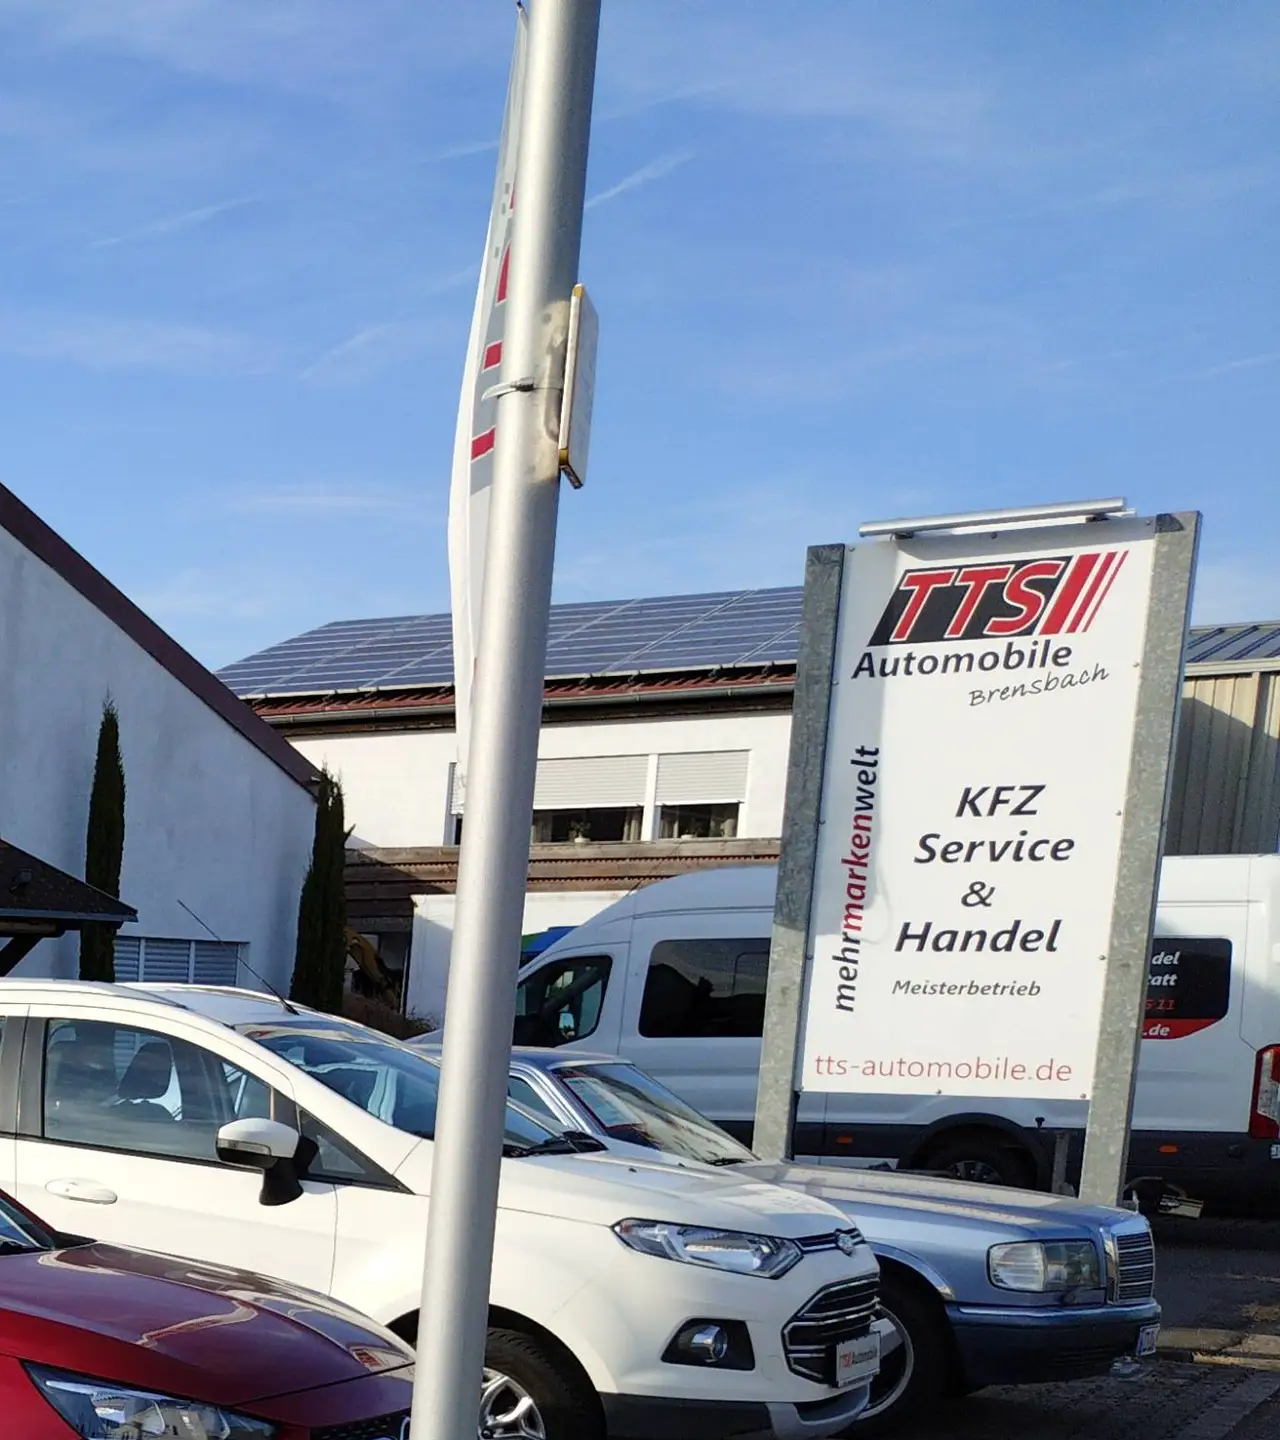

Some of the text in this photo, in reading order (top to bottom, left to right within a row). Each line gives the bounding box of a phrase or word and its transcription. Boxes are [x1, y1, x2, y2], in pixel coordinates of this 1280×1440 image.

[888, 559, 1067, 643] TTS
[851, 639, 1073, 680] Automobile
[968, 663, 1110, 707] Brensbach
[954, 784, 1046, 818] KFZ
[913, 830, 1075, 864] Service
[832, 744, 880, 1012] mehrmarkenwelt
[960, 880, 996, 908] &
[894, 919, 1062, 953] Handel
[1151, 951, 1181, 965] del
[891, 979, 1041, 997] Meisterbetrieb
[1142, 1023, 1171, 1036] .de
[815, 1054, 1073, 1082] tts-automobile.de
